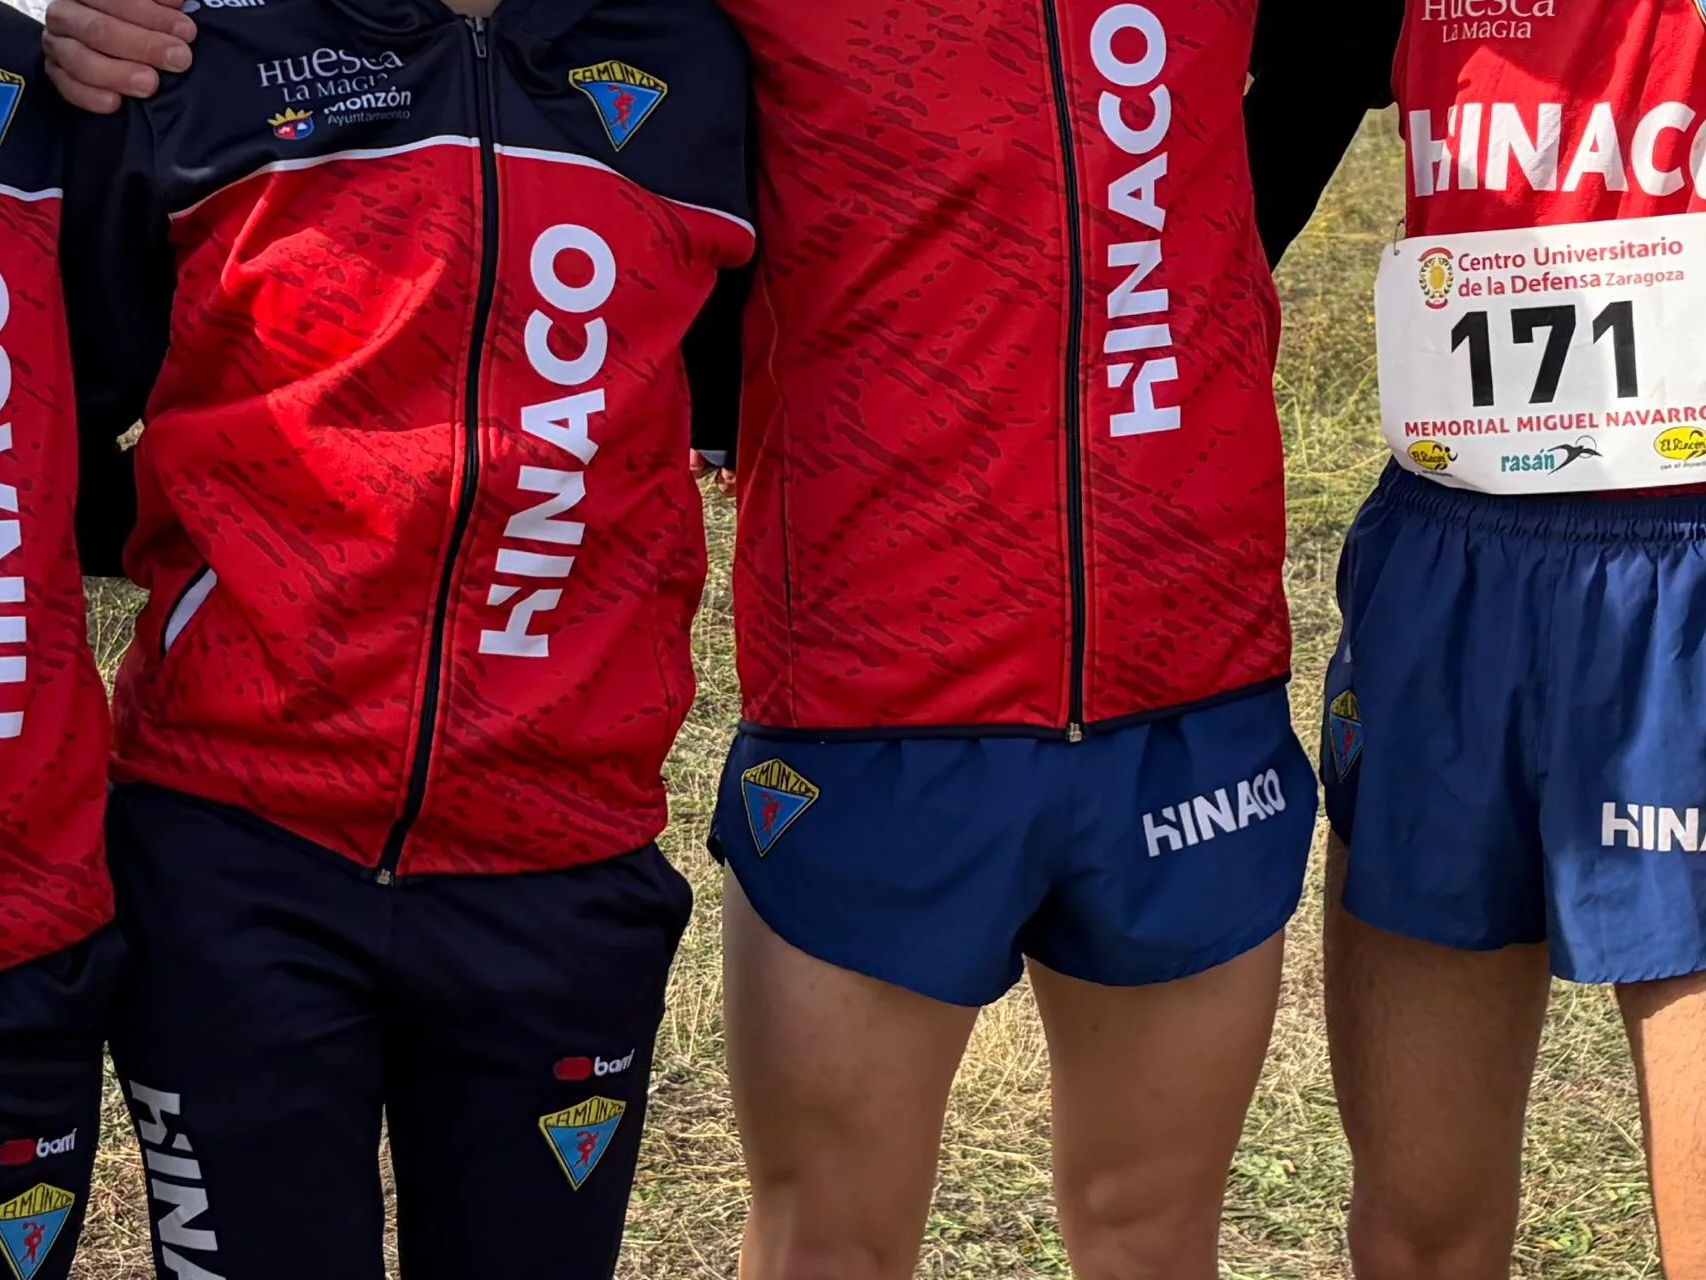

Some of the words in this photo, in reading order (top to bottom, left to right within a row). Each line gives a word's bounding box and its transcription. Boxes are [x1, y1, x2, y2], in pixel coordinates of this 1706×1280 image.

[1090, 3, 1181, 438] HINACO
[1458, 252, 1526, 272] Centro
[1533, 236, 1683, 266] Universitario
[1457, 277, 1482, 297] de
[1487, 276, 1506, 296] la
[1511, 271, 1601, 295] Defensa
[1605, 268, 1685, 287] Zaragoza
[1451, 300, 1638, 407] 171
[478, 223, 617, 658] HINACO
[1405, 416, 1510, 438] MEMORIAL
[1516, 412, 1600, 432] MIGUEL
[1501, 448, 1555, 472] rasán
[1142, 767, 1287, 858] HINACO
[36, 1127, 78, 1148] barri
